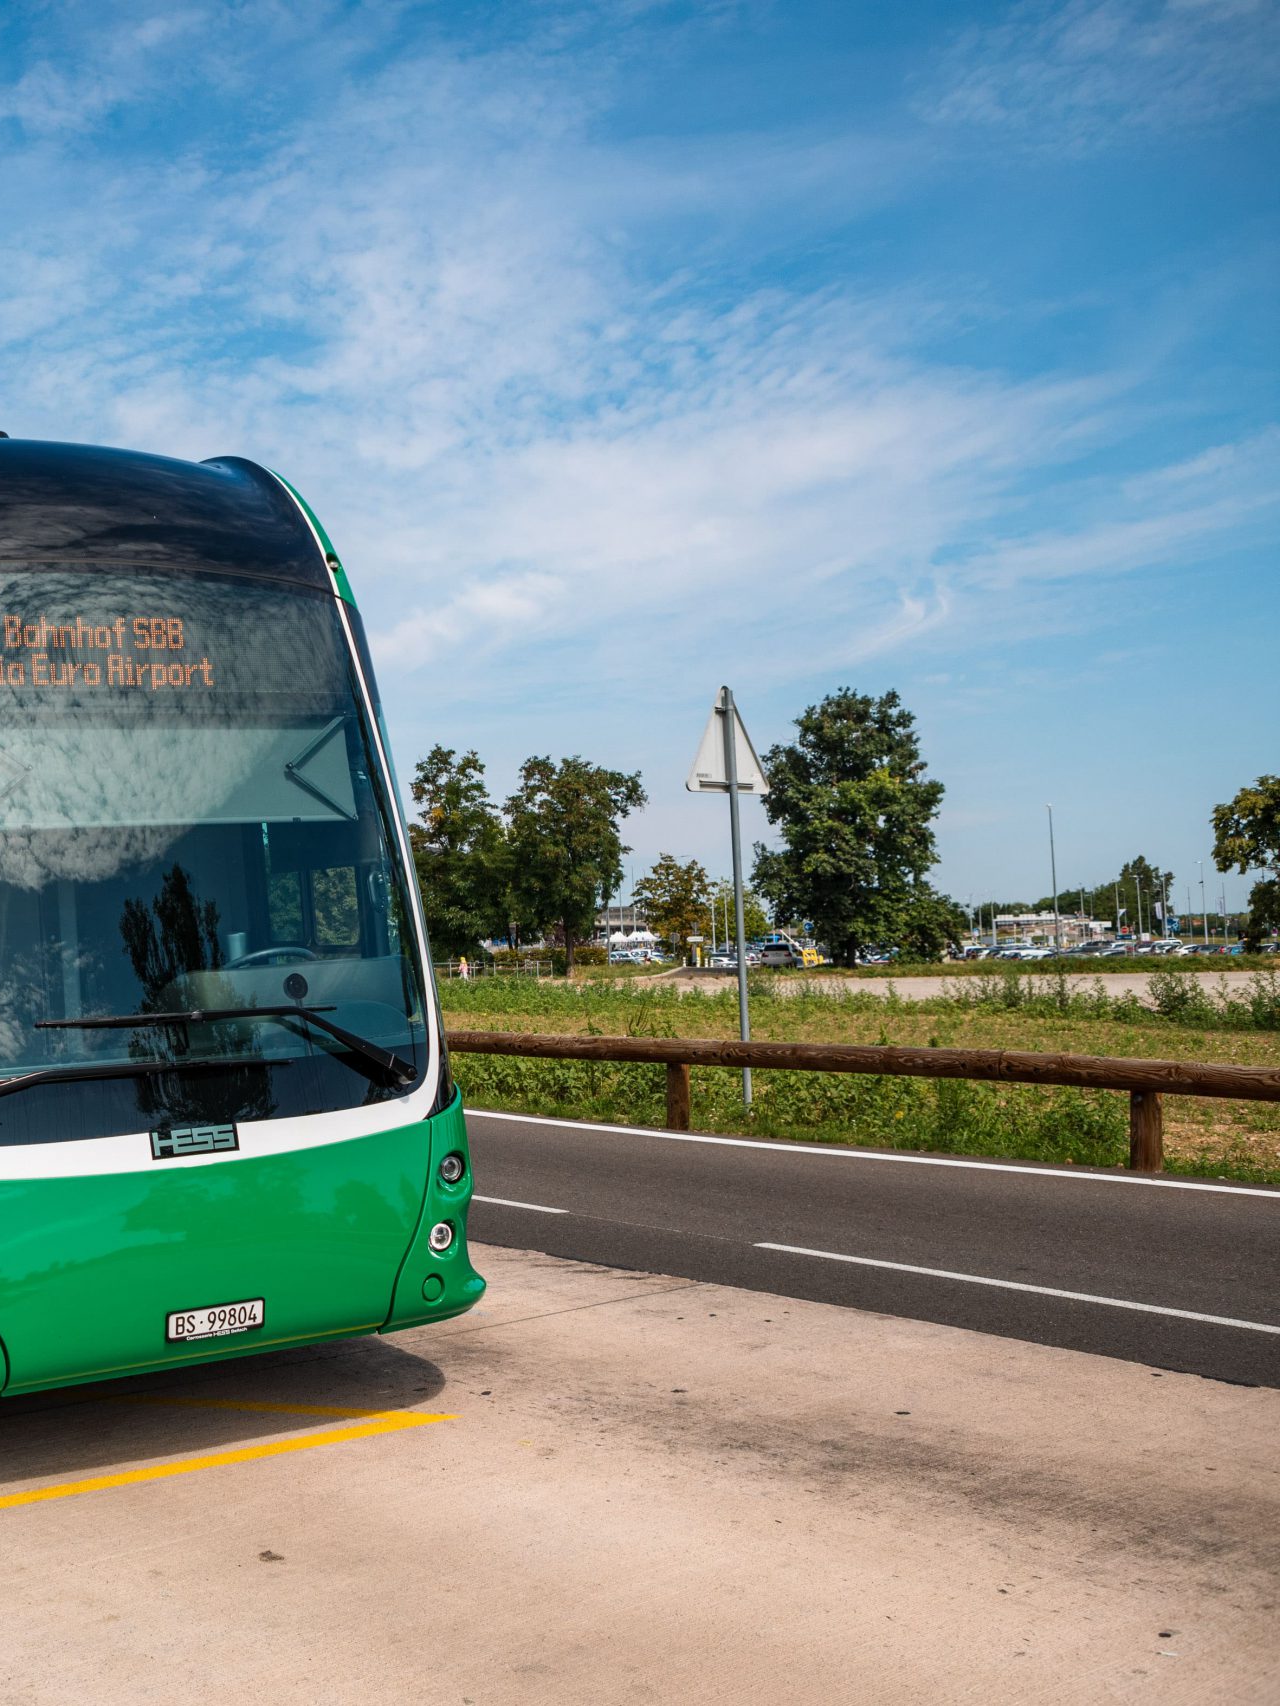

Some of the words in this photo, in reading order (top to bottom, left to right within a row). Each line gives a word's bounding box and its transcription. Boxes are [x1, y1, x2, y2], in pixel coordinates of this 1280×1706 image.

[3, 615, 126, 649] Bahnhof
[133, 617, 185, 649] SBB
[31, 653, 101, 686] Euro
[107, 654, 214, 690] Airport
[152, 1124, 236, 1156] HESS
[207, 1304, 257, 1331] 99804
